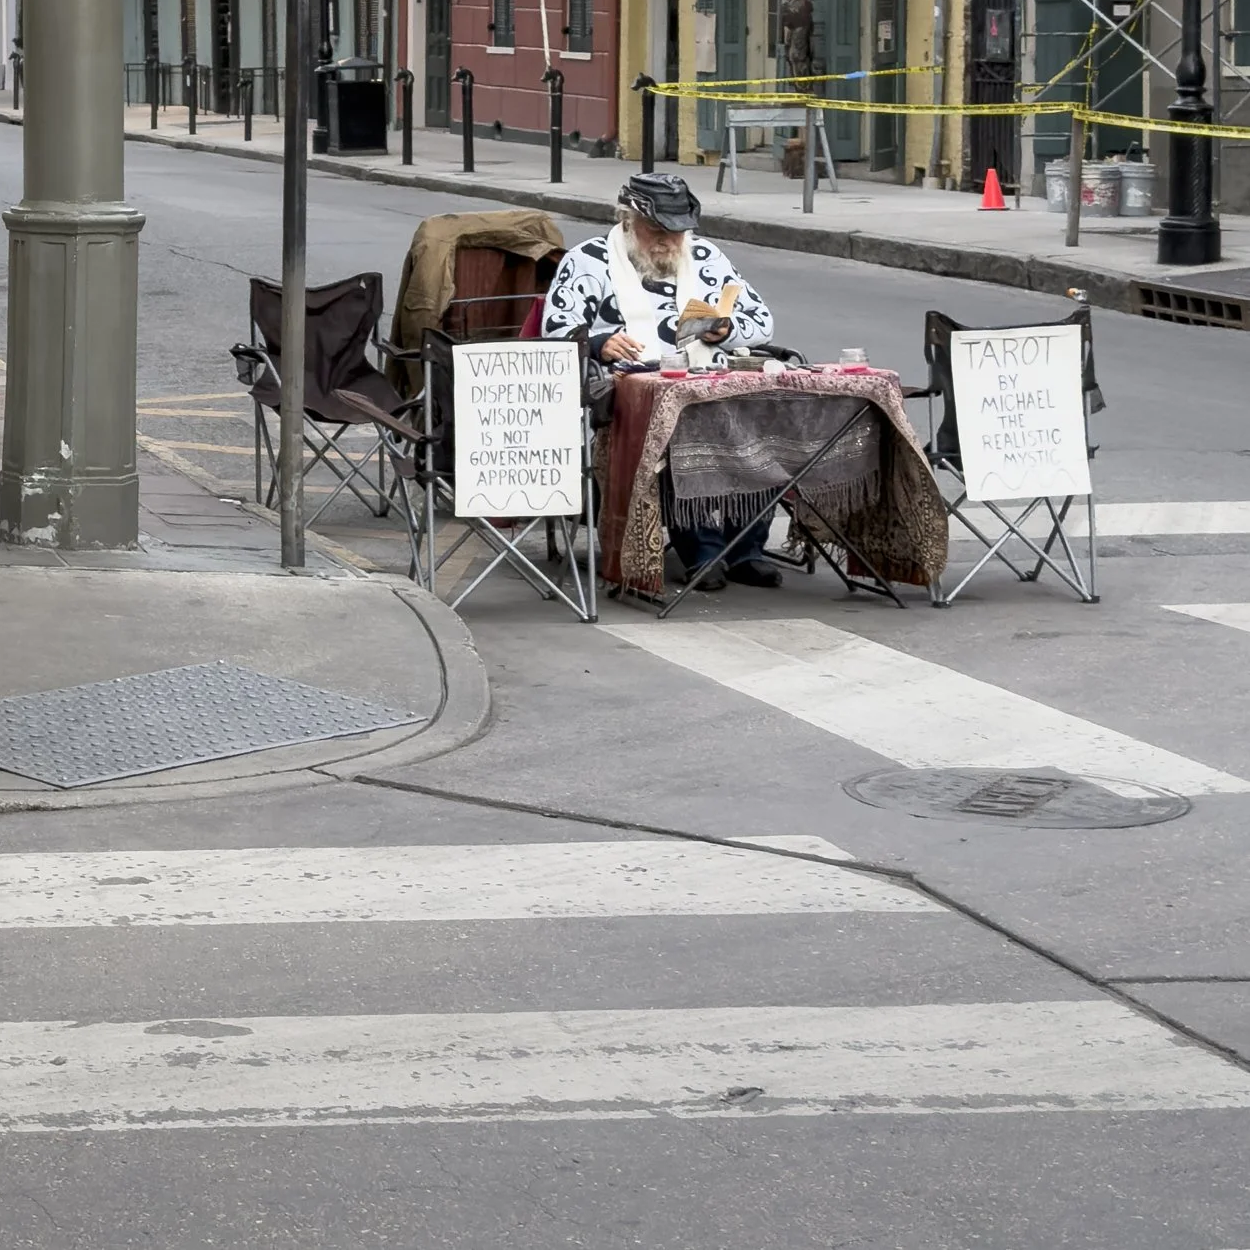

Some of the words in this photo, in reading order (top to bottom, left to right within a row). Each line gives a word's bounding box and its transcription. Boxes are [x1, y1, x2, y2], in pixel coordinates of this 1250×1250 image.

[960, 336, 1060, 370] TAROT
[998, 373, 1018, 391] BY
[471, 382, 563, 404] DISPENSING
[981, 390, 1056, 414] MICHAEL
[477, 407, 544, 427] WISDOM
[997, 413, 1025, 430] THE
[481, 430, 493, 446] IS
[503, 430, 530, 445] NOT
[981, 428, 1063, 450] REALISTIC
[469, 447, 573, 467] GOVERNMENT
[1003, 449, 1062, 468] MYSTIC
[476, 468, 562, 487] APPROVED
